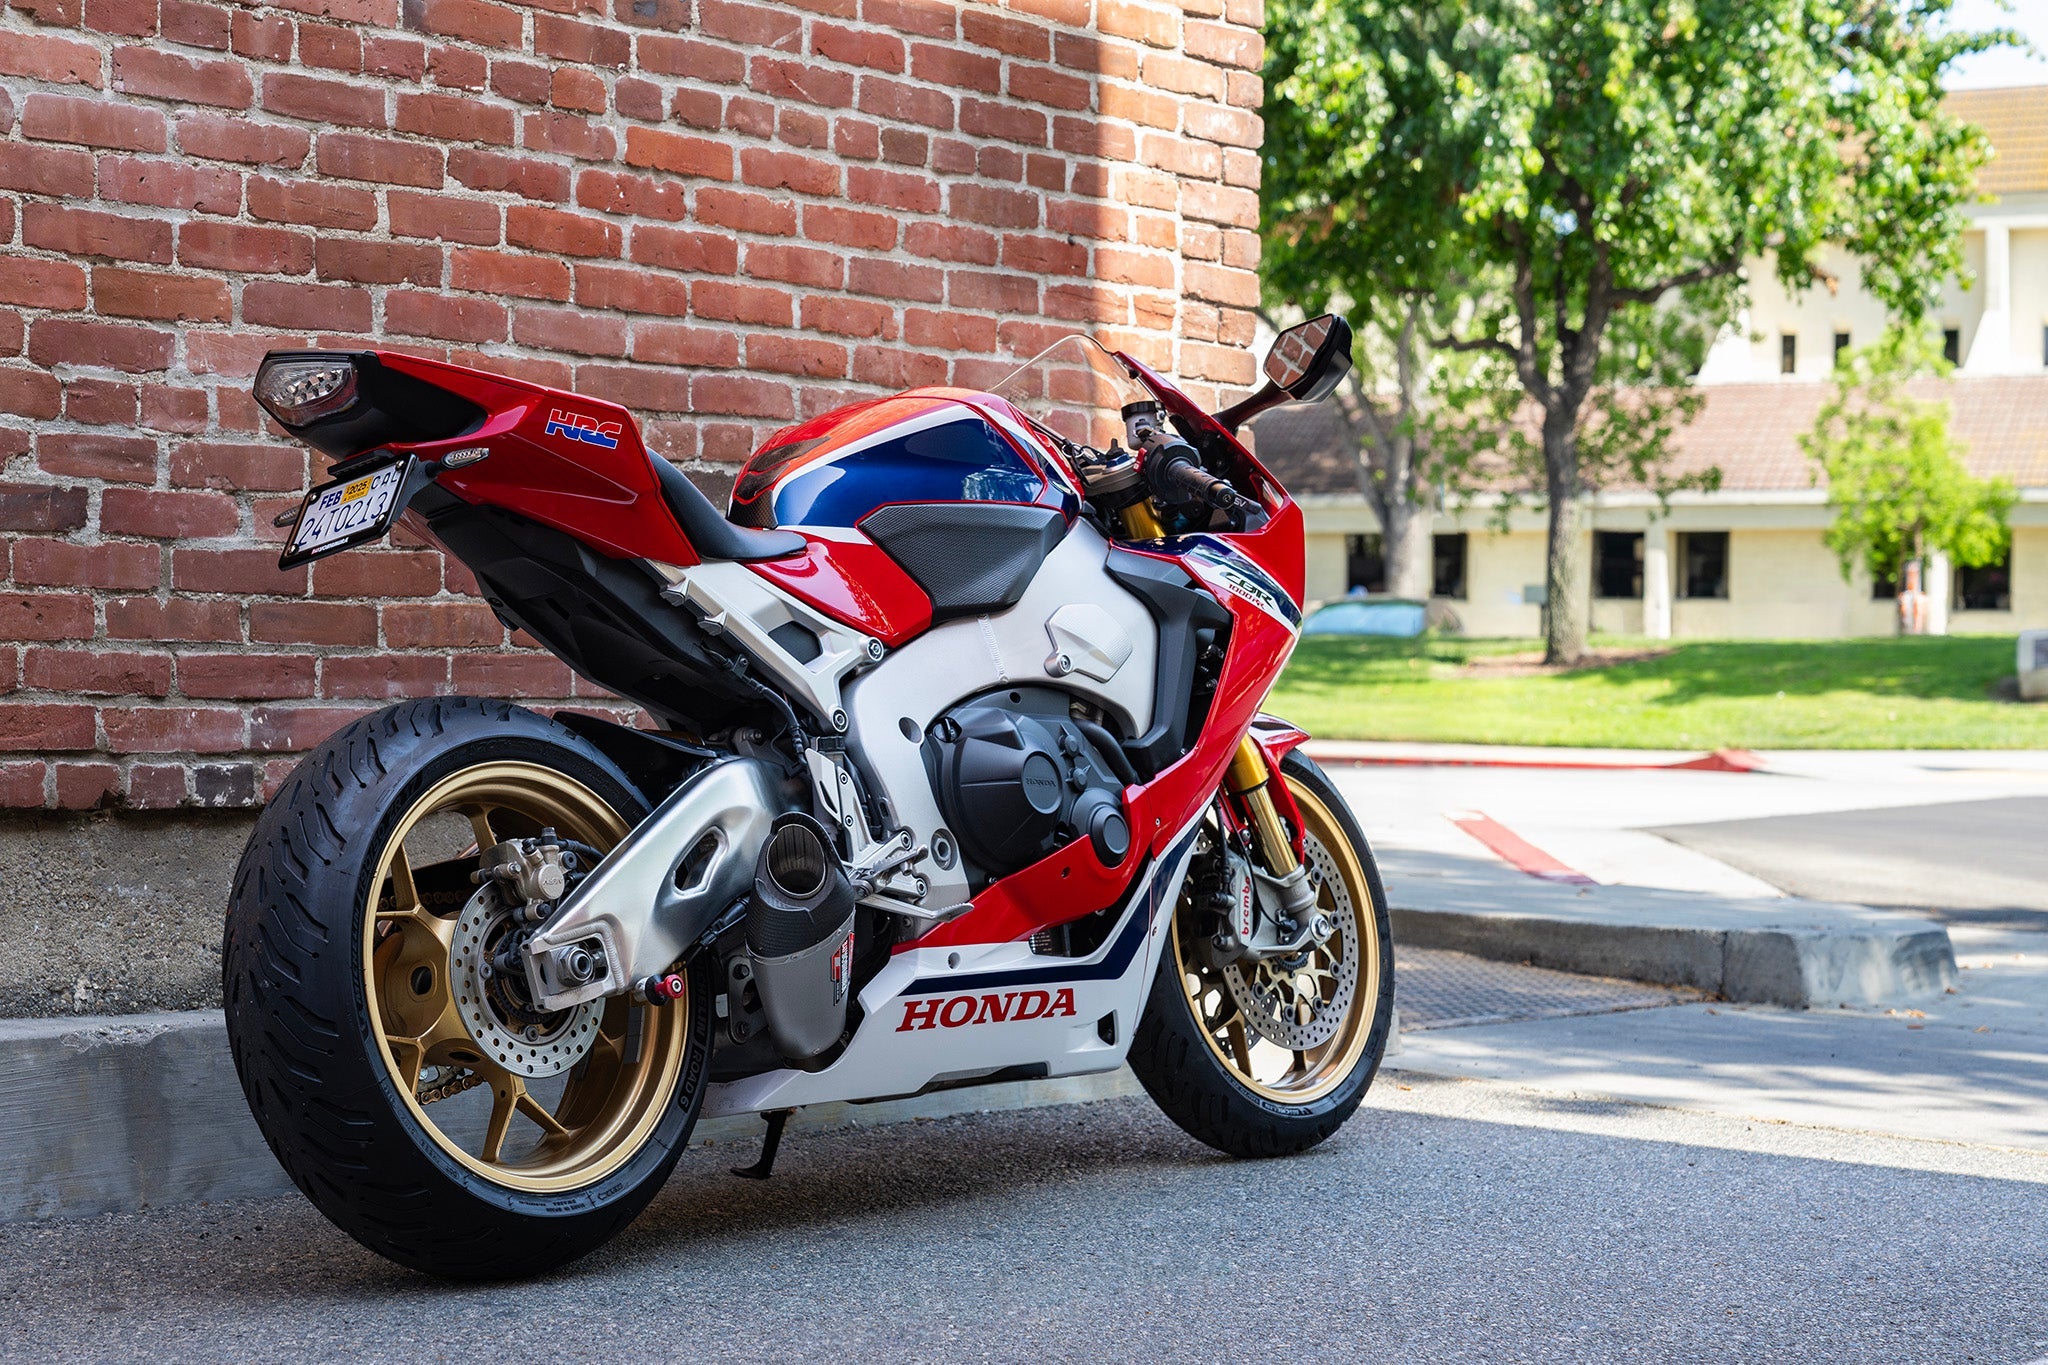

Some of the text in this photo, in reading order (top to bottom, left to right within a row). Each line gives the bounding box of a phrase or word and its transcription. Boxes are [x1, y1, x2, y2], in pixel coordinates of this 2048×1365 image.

[545, 408, 622, 450] HRC
[319, 490, 343, 511] FEB
[348, 481, 368, 495] 2025
[298, 492, 388, 547] 24T0213
[1222, 571, 1274, 609] CBR
[1026, 777, 1056, 787] HONDA
[1241, 876, 1250, 936] brembo
[895, 988, 1077, 1032] HONDA
[685, 1051, 703, 1095] ROAD
[680, 1097, 690, 1109] 6
